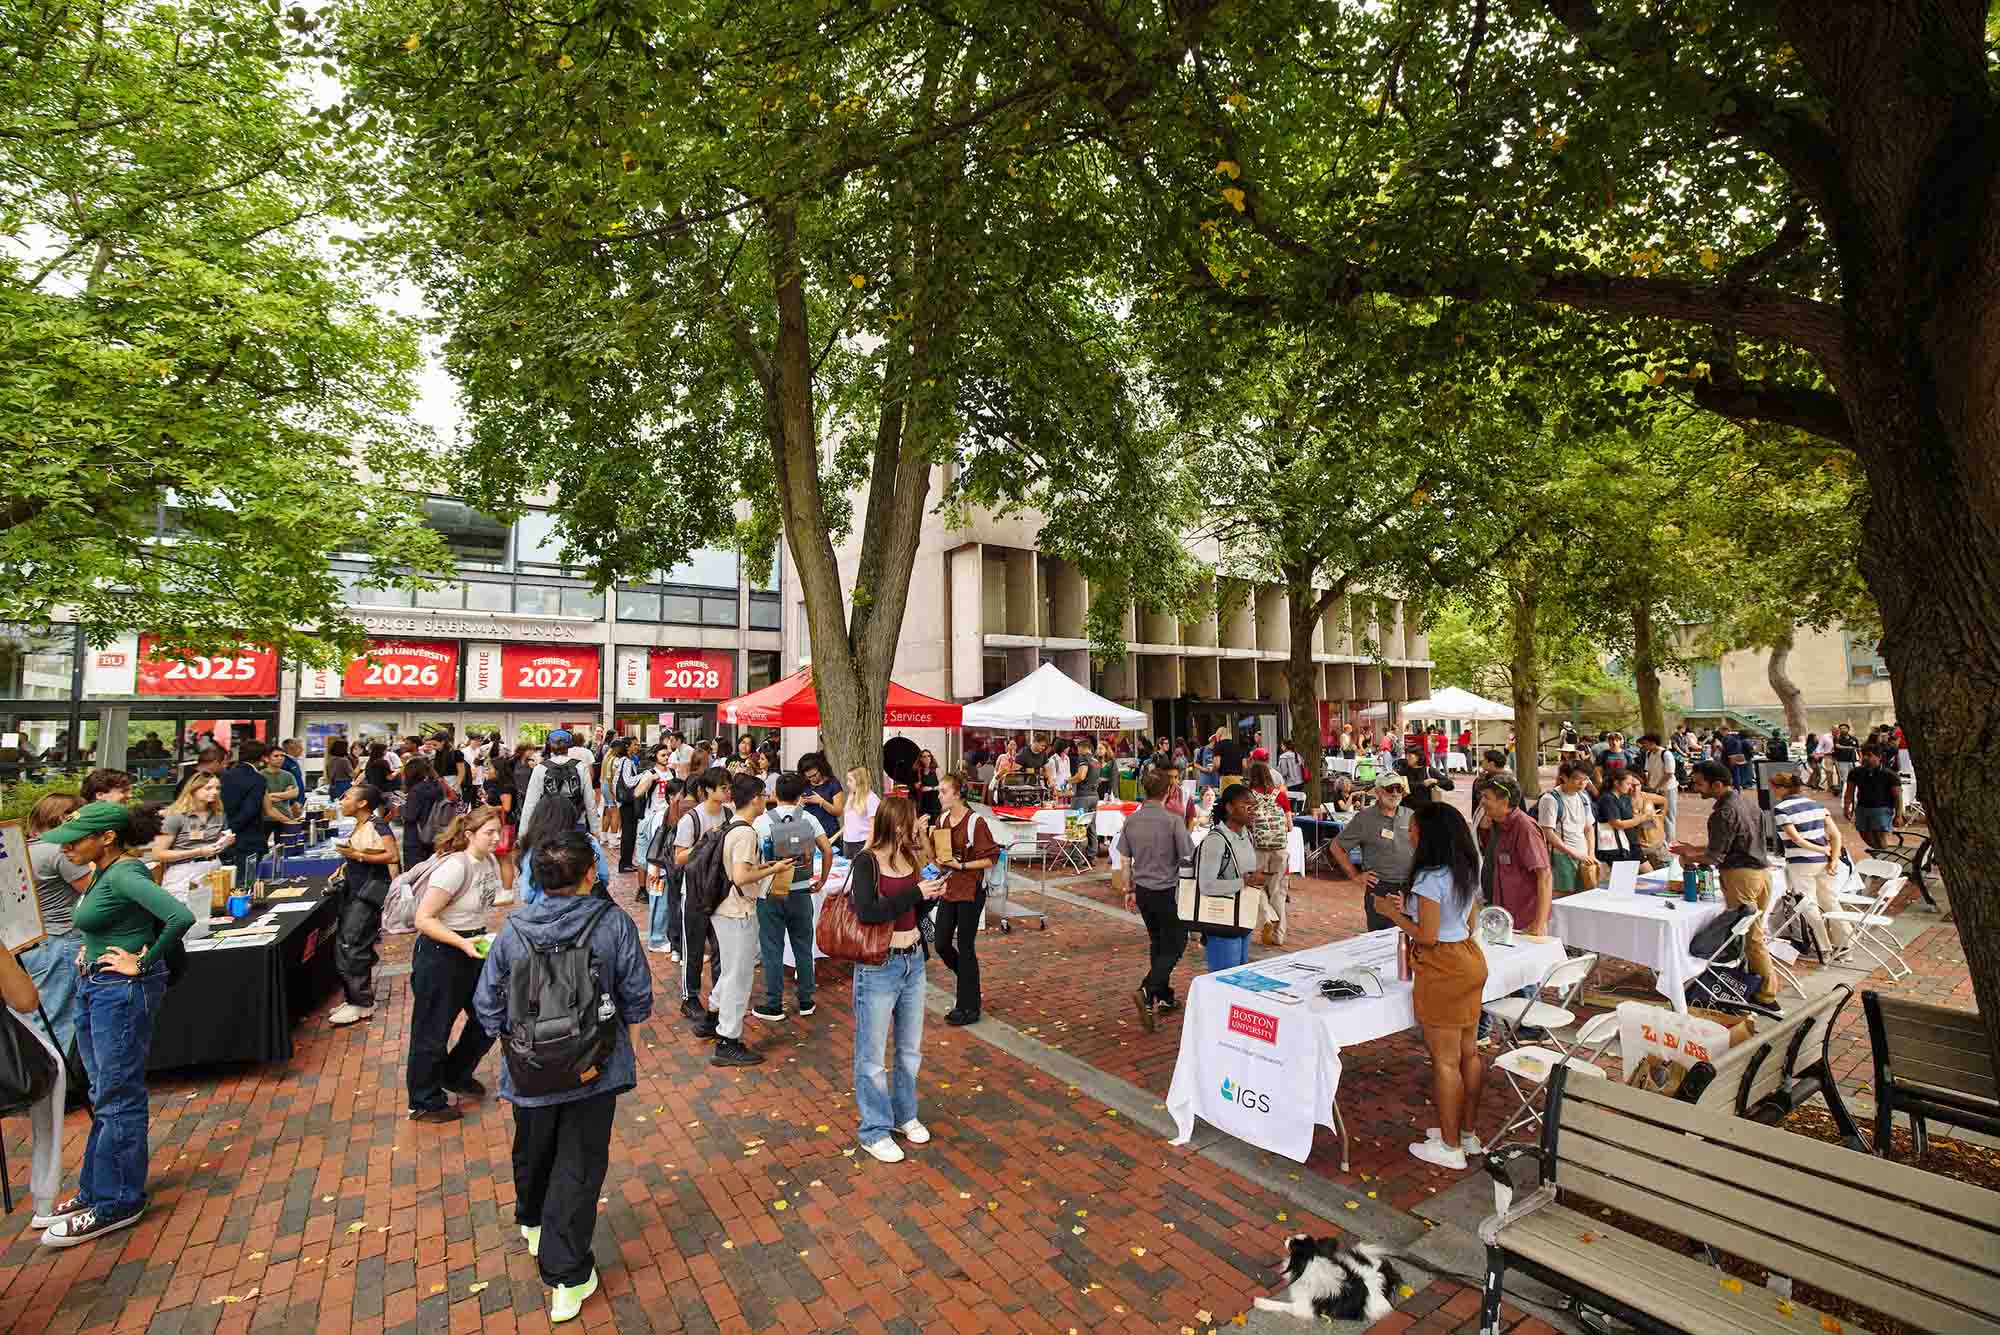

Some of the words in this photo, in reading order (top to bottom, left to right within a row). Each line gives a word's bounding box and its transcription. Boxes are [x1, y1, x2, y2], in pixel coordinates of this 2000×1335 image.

[348, 615, 417, 631] EORGE
[424, 618, 512, 634] SHERMAN
[519, 620, 576, 638] UNION
[394, 647, 451, 664] UNIVERSITY
[532, 656, 572, 668] TERRIERS
[675, 659, 709, 670] TERRIERS
[163, 656, 256, 680] 2025
[363, 663, 440, 686] 2026
[479, 651, 489, 690] VIRTUE
[518, 666, 583, 688] 2027
[627, 658, 639, 687] PIETY
[663, 669, 720, 689] 2028
[890, 710, 932, 722] Services
[1075, 715, 1093, 729] HOT
[1094, 715, 1121, 729] SAUCE
[1231, 1020, 1273, 1040] UNIVERSITY
[1232, 1008, 1275, 1030] BOSTON
[1236, 1085, 1271, 1114] IGS
